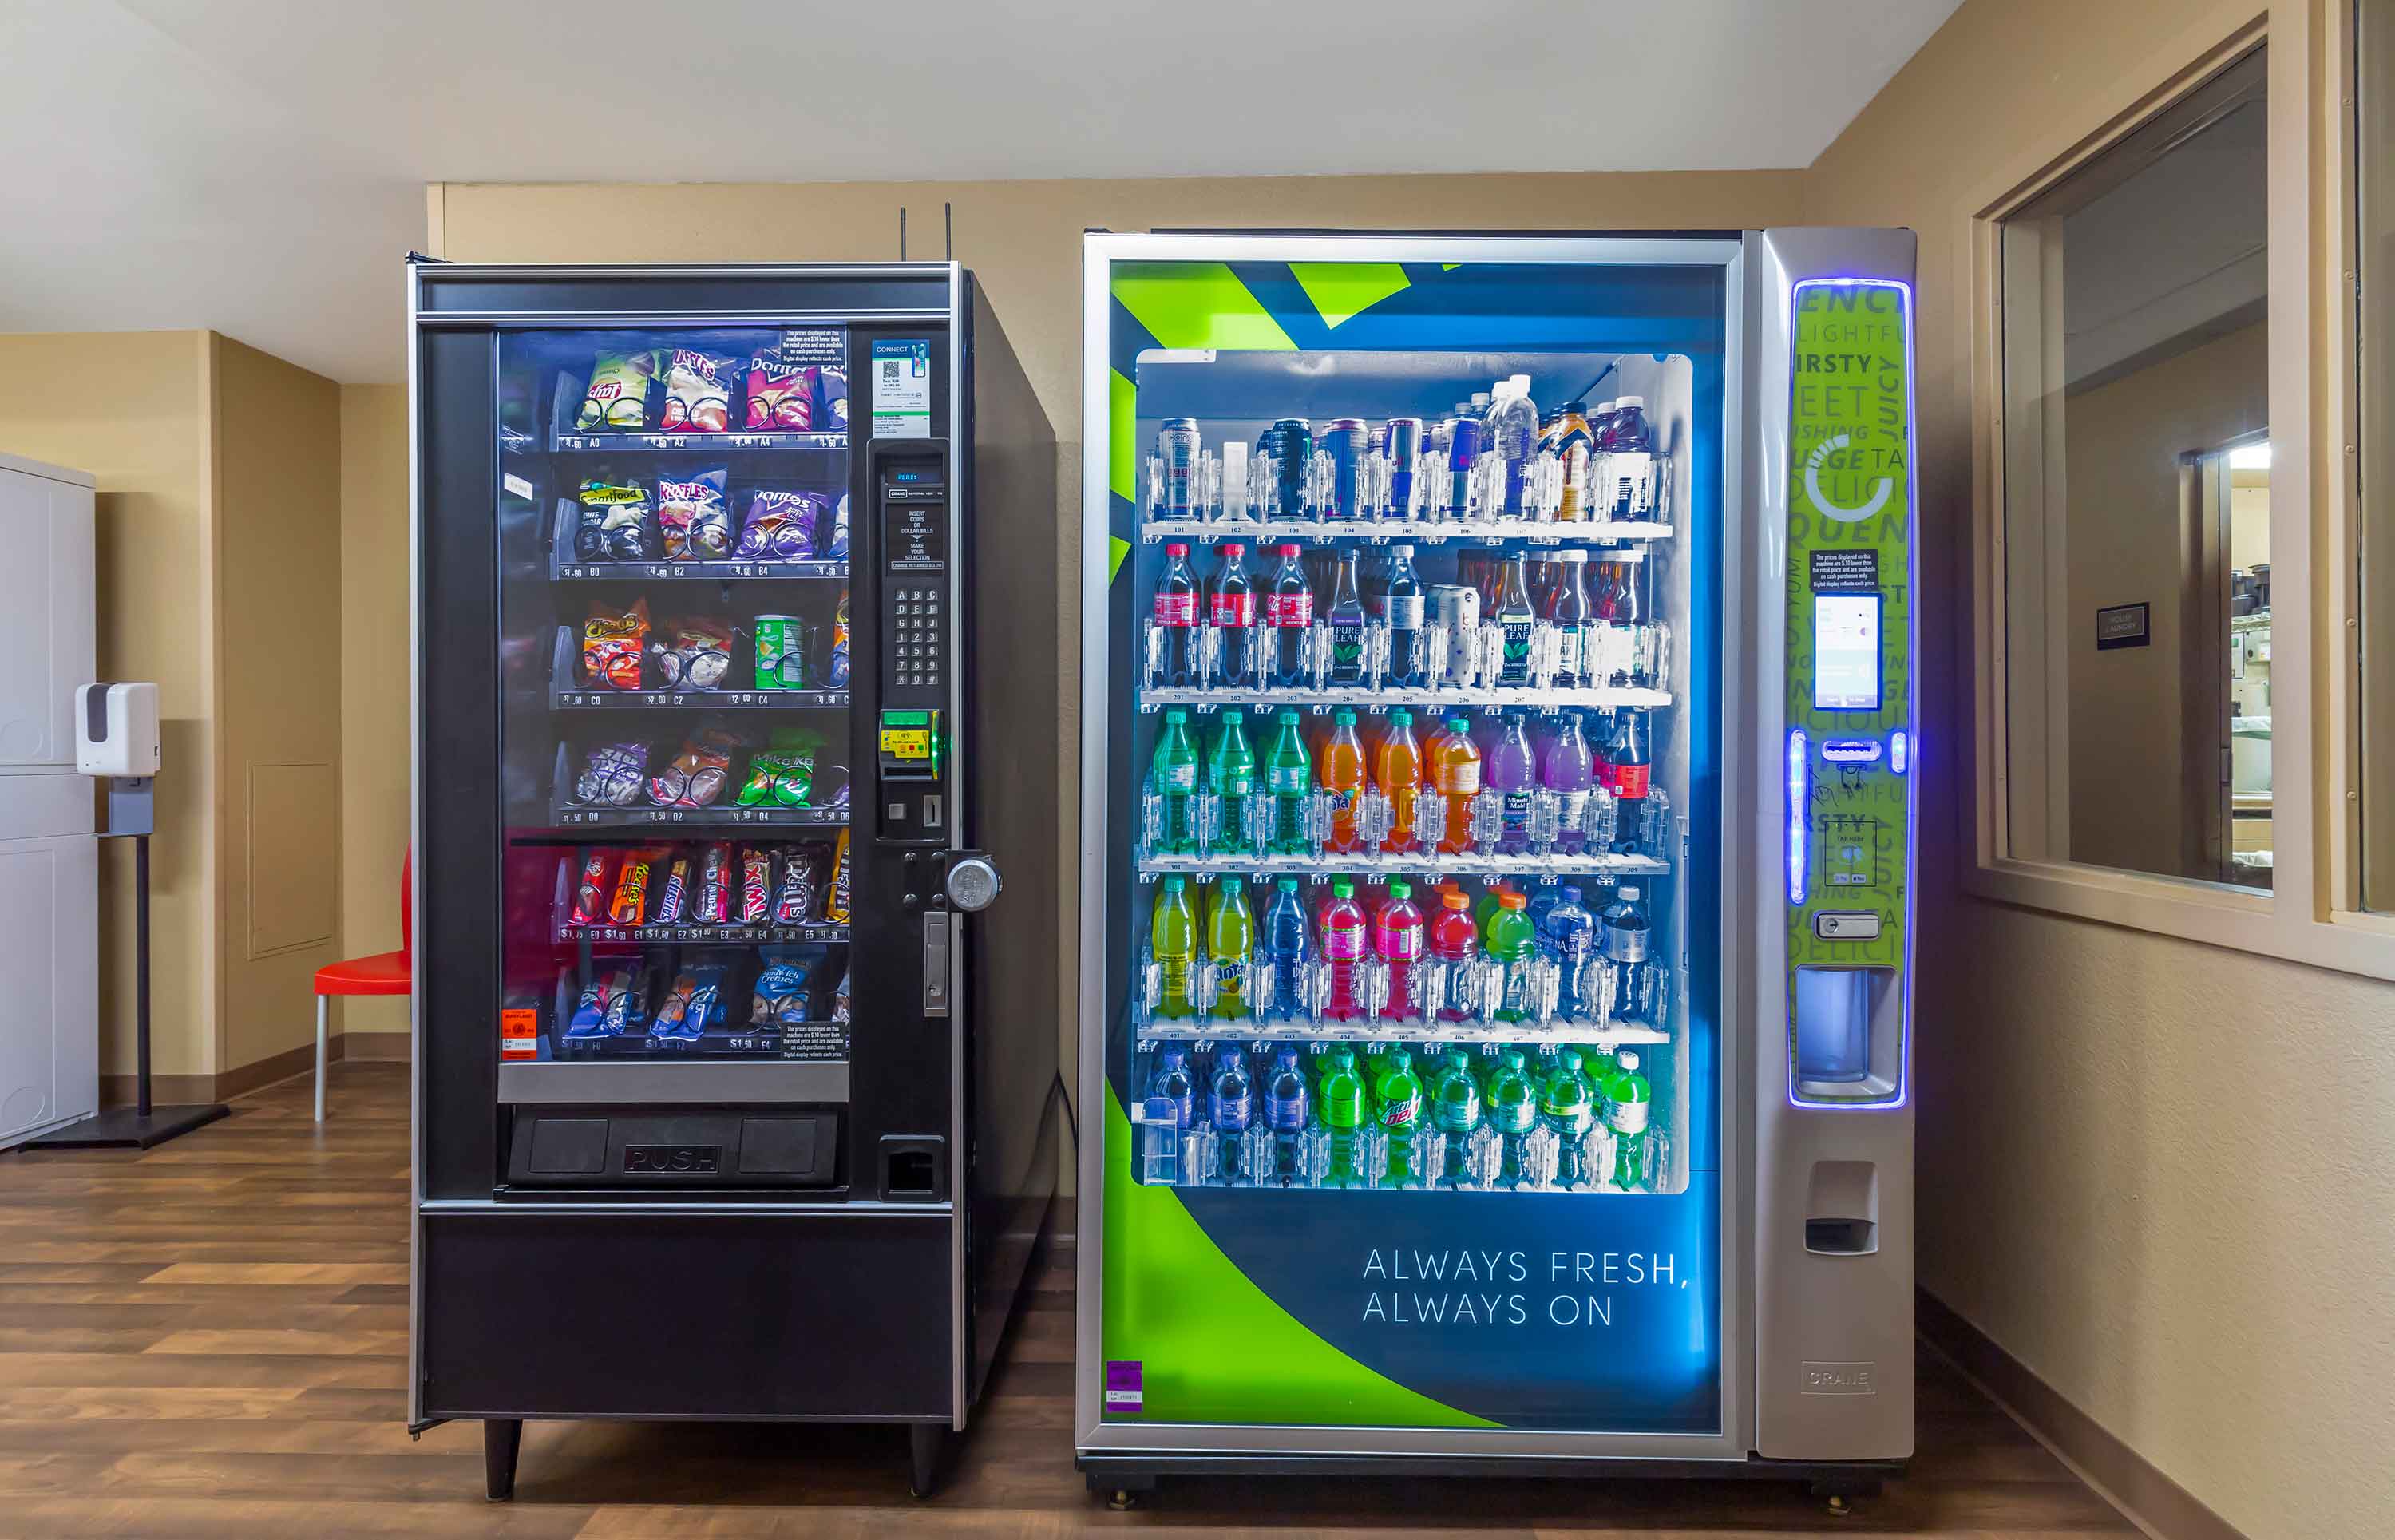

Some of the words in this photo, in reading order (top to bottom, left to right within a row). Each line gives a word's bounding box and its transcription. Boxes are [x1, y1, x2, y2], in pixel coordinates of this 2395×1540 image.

[1878, 356, 1899, 443] JUICY
[743, 865, 767, 920] TWIX
[806, 930, 814, 939] E5
[1217, 964, 1244, 981] anta
[628, 1150, 717, 1171] PUSH
[1362, 1249, 1527, 1282] ALWAYS
[1552, 1251, 1688, 1289] FRESH,
[1361, 1292, 1526, 1326] ALWAYS
[1549, 1295, 1611, 1326] ON
